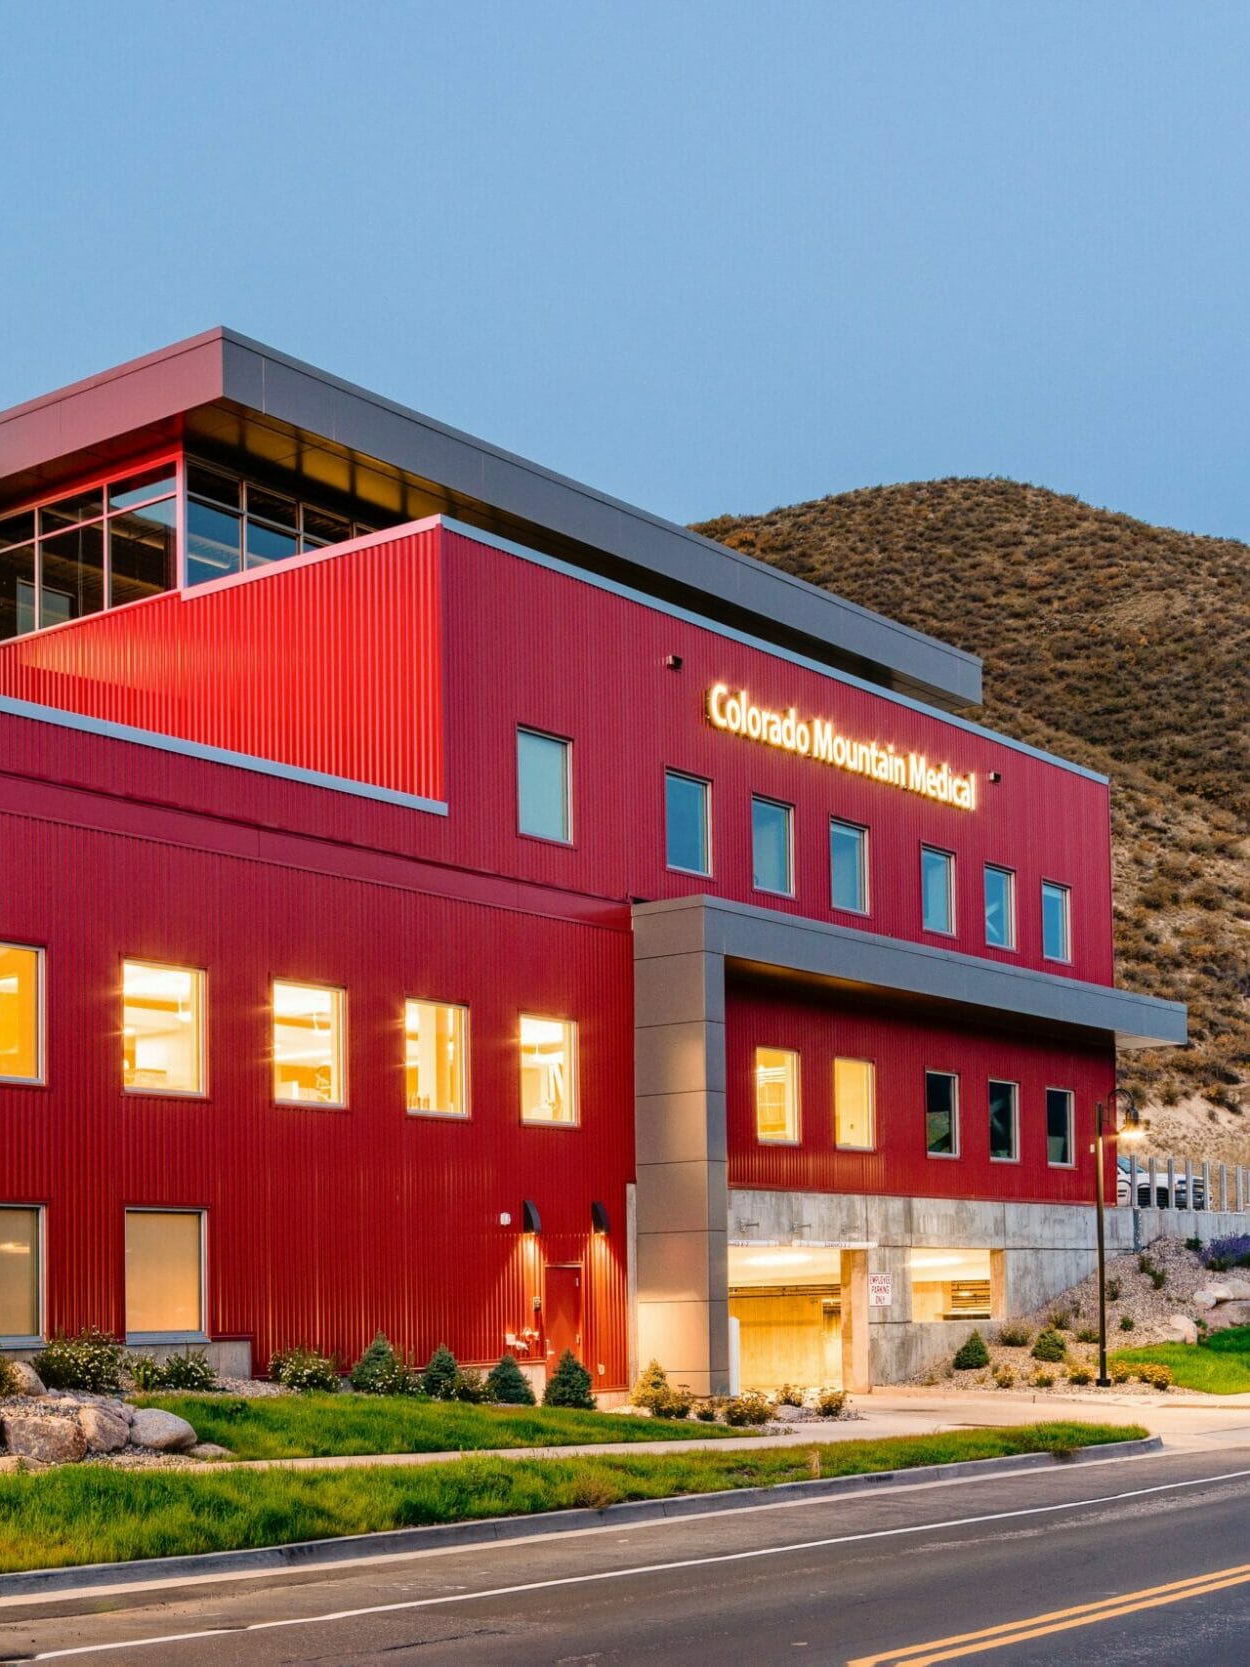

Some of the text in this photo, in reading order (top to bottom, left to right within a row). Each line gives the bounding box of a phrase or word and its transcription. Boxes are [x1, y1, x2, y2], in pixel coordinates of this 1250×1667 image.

[711, 684, 976, 811] Colorado Mountain Medical
[871, 1285, 890, 1295] PARKING
